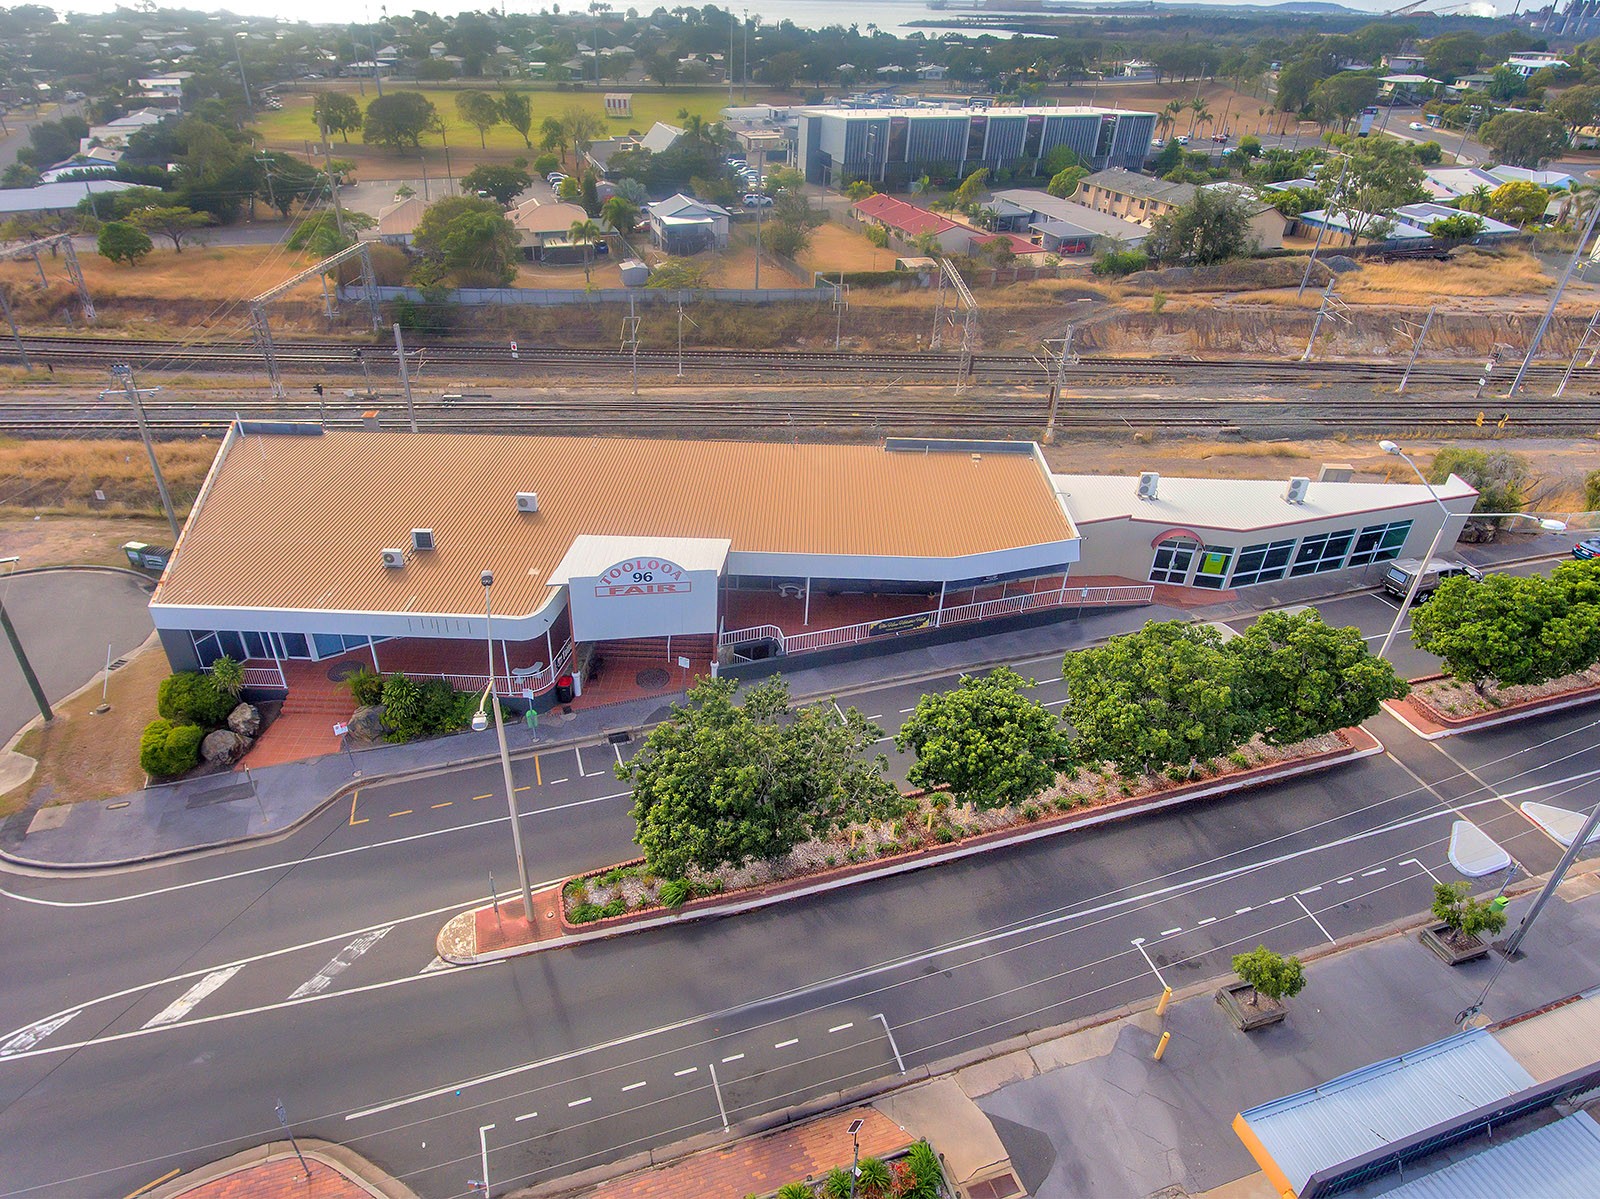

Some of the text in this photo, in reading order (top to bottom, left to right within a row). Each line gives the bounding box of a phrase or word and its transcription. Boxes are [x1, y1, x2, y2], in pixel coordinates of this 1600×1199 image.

[600, 560, 682, 586] TOOLOOA
[632, 571, 654, 583] 96
[609, 584, 676, 595] FAIR
